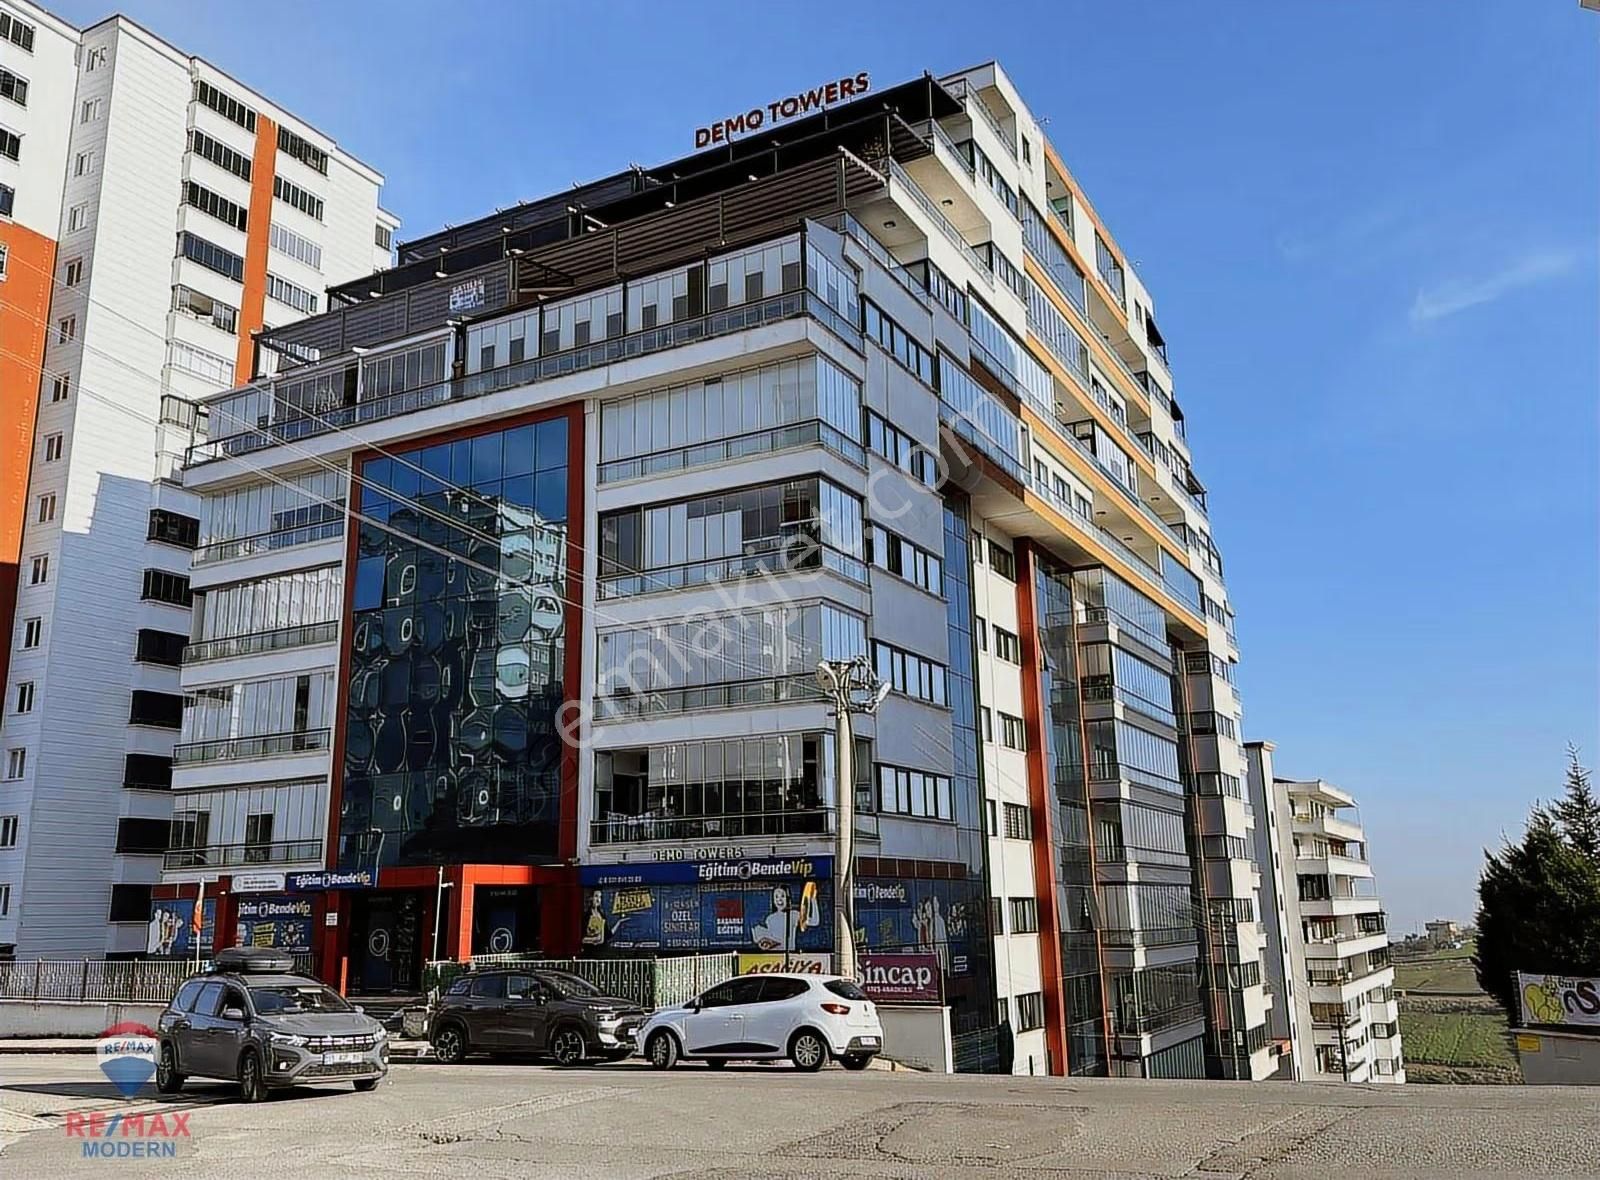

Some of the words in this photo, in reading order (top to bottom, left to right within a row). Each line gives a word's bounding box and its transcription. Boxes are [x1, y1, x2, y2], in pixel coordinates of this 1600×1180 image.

[695, 109, 764, 149] DEMO
[767, 72, 870, 123] TOWERS
[652, 848, 684, 861] DEMO
[694, 846, 744, 860] TOWERS
[699, 861, 738, 880] Eğitim
[751, 860, 812, 877] BendeVip
